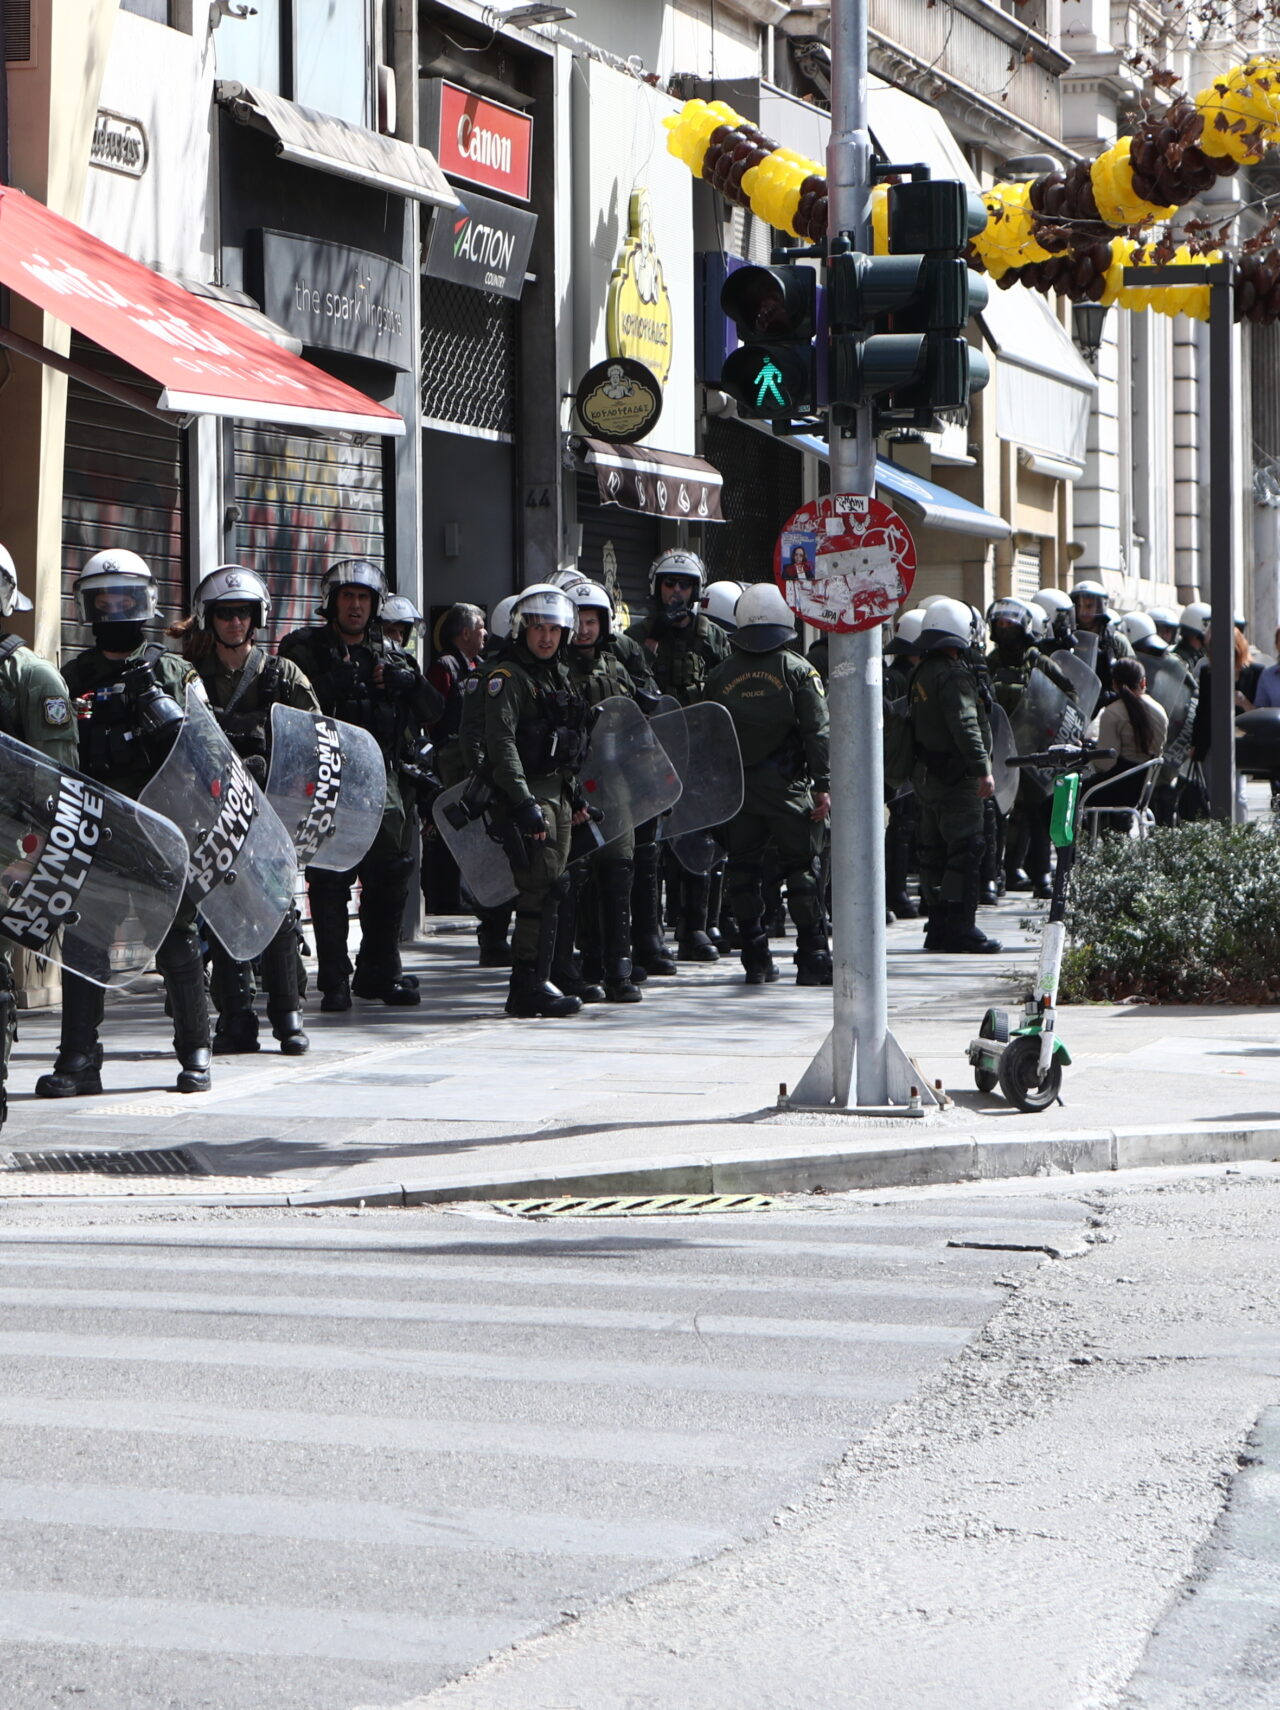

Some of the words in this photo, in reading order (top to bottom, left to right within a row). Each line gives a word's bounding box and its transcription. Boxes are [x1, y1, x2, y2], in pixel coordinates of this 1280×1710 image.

[457, 114, 512, 174] Canon
[459, 220, 515, 272] ACTION
[485, 272, 507, 289] COUNTRY
[295, 281, 321, 314] the
[525, 487, 551, 508] 44
[741, 690, 765, 698] POLICE
[185, 750, 246, 885] ΑΣΤΥΝΟΜΙΑ
[197, 769, 254, 893] POLICE
[295, 722, 331, 860] ΑΣΤΥΝΟΜΙΑ
[307, 728, 342, 854] POLICE
[1, 776, 85, 937] ΑΣΤΥΝΟΜΙΑ
[27, 791, 104, 941] POLICE
